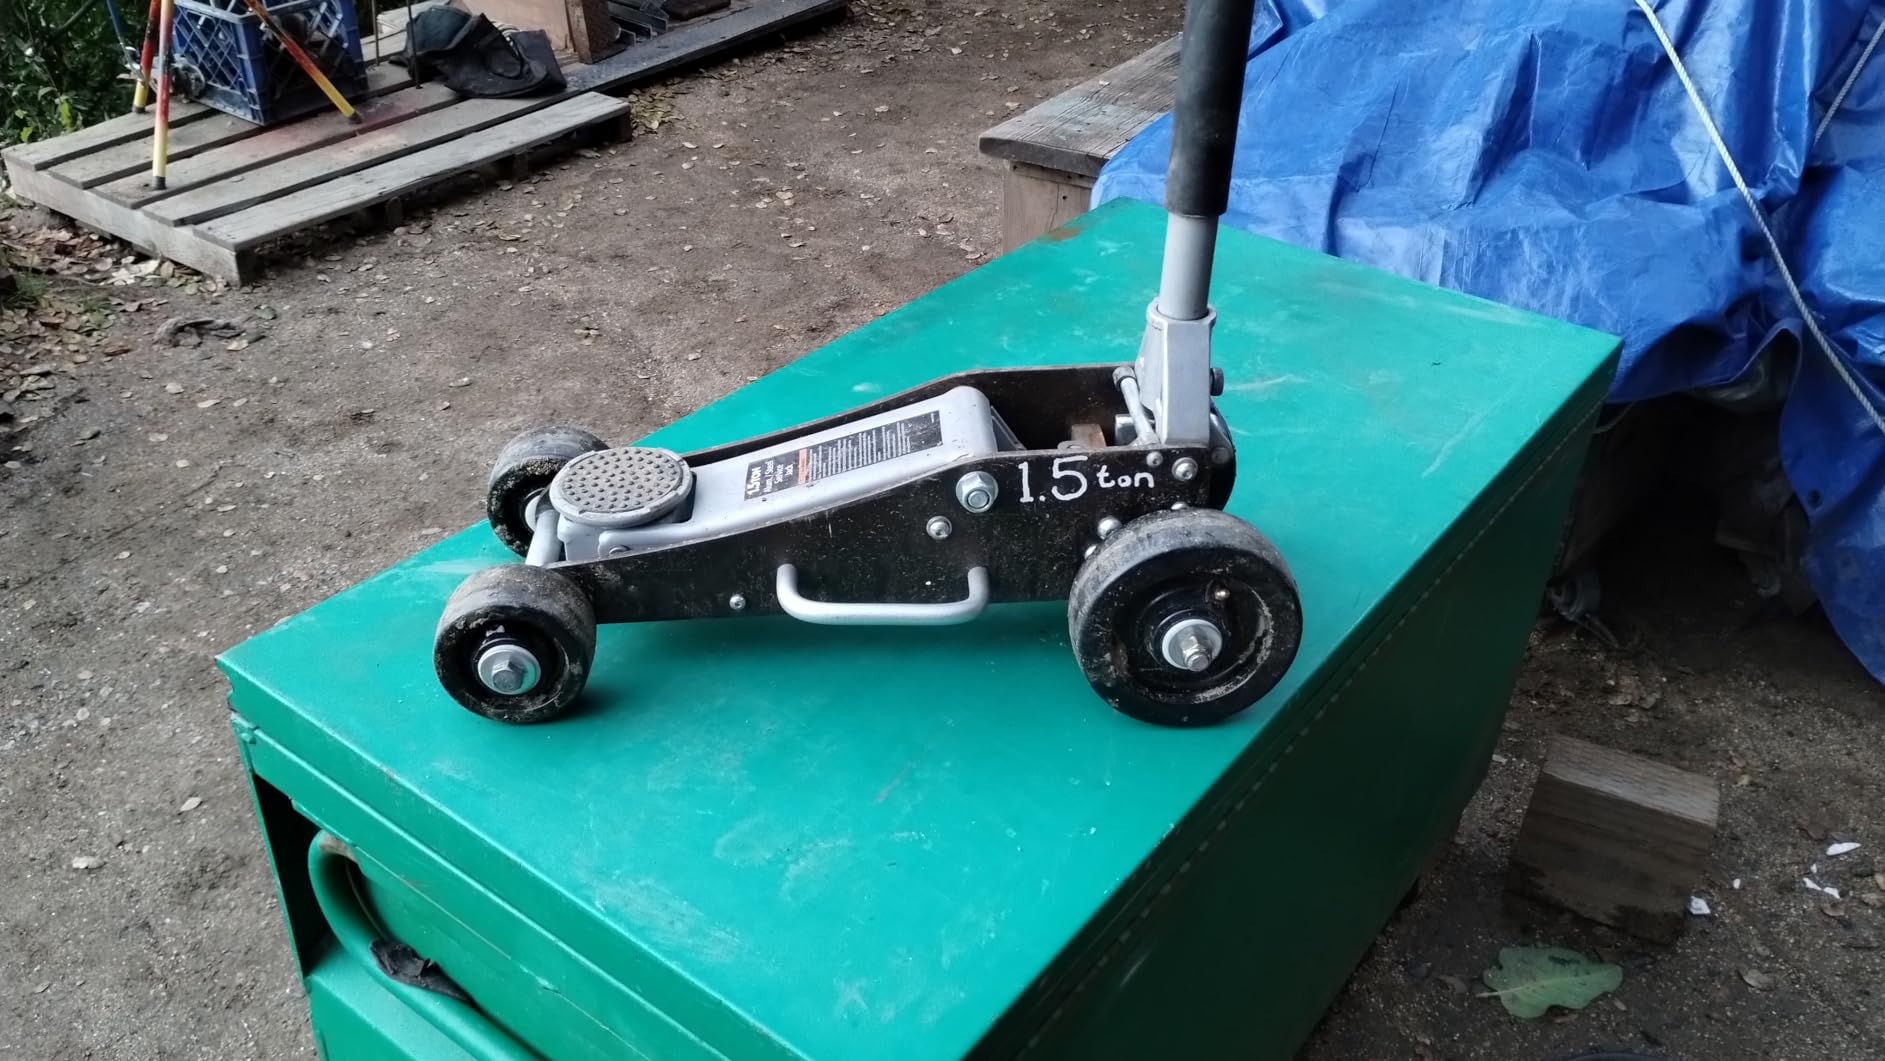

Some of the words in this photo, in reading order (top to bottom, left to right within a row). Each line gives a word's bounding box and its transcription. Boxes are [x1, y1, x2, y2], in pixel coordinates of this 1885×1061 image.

[774, 464, 783, 484] Service
[785, 464, 794, 476] Jack
[1018, 455, 1088, 502] 1.5
[1096, 465, 1155, 488] ton
